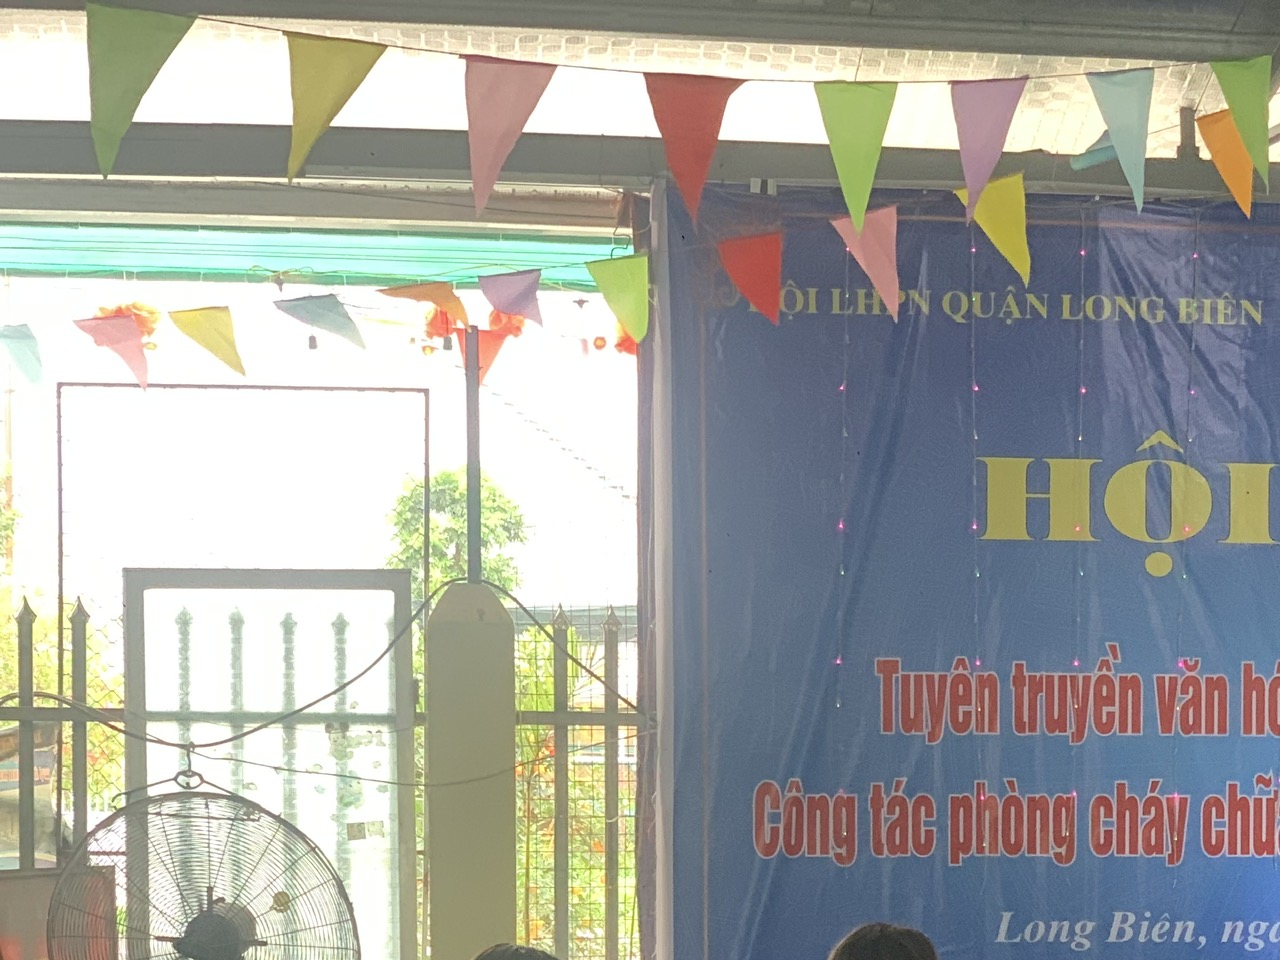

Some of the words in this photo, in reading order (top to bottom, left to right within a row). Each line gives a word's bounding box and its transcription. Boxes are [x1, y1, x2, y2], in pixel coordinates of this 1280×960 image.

[748, 279, 819, 320] ỘI
[942, 286, 1048, 325] QUẬN
[1060, 293, 1166, 325] LONG
[1178, 290, 1264, 327] BIÊN
[978, 430, 1279, 578] HỘI
[875, 656, 1000, 745] Tuyên
[1012, 642, 1143, 745] truyền
[1155, 657, 1229, 737] văn
[752, 778, 858, 867] Công
[869, 777, 936, 858] tác
[948, 777, 1077, 867] phòng
[1089, 778, 1189, 866] cháy
[995, 911, 1097, 952] Long
[1107, 910, 1208, 950] Biên,
